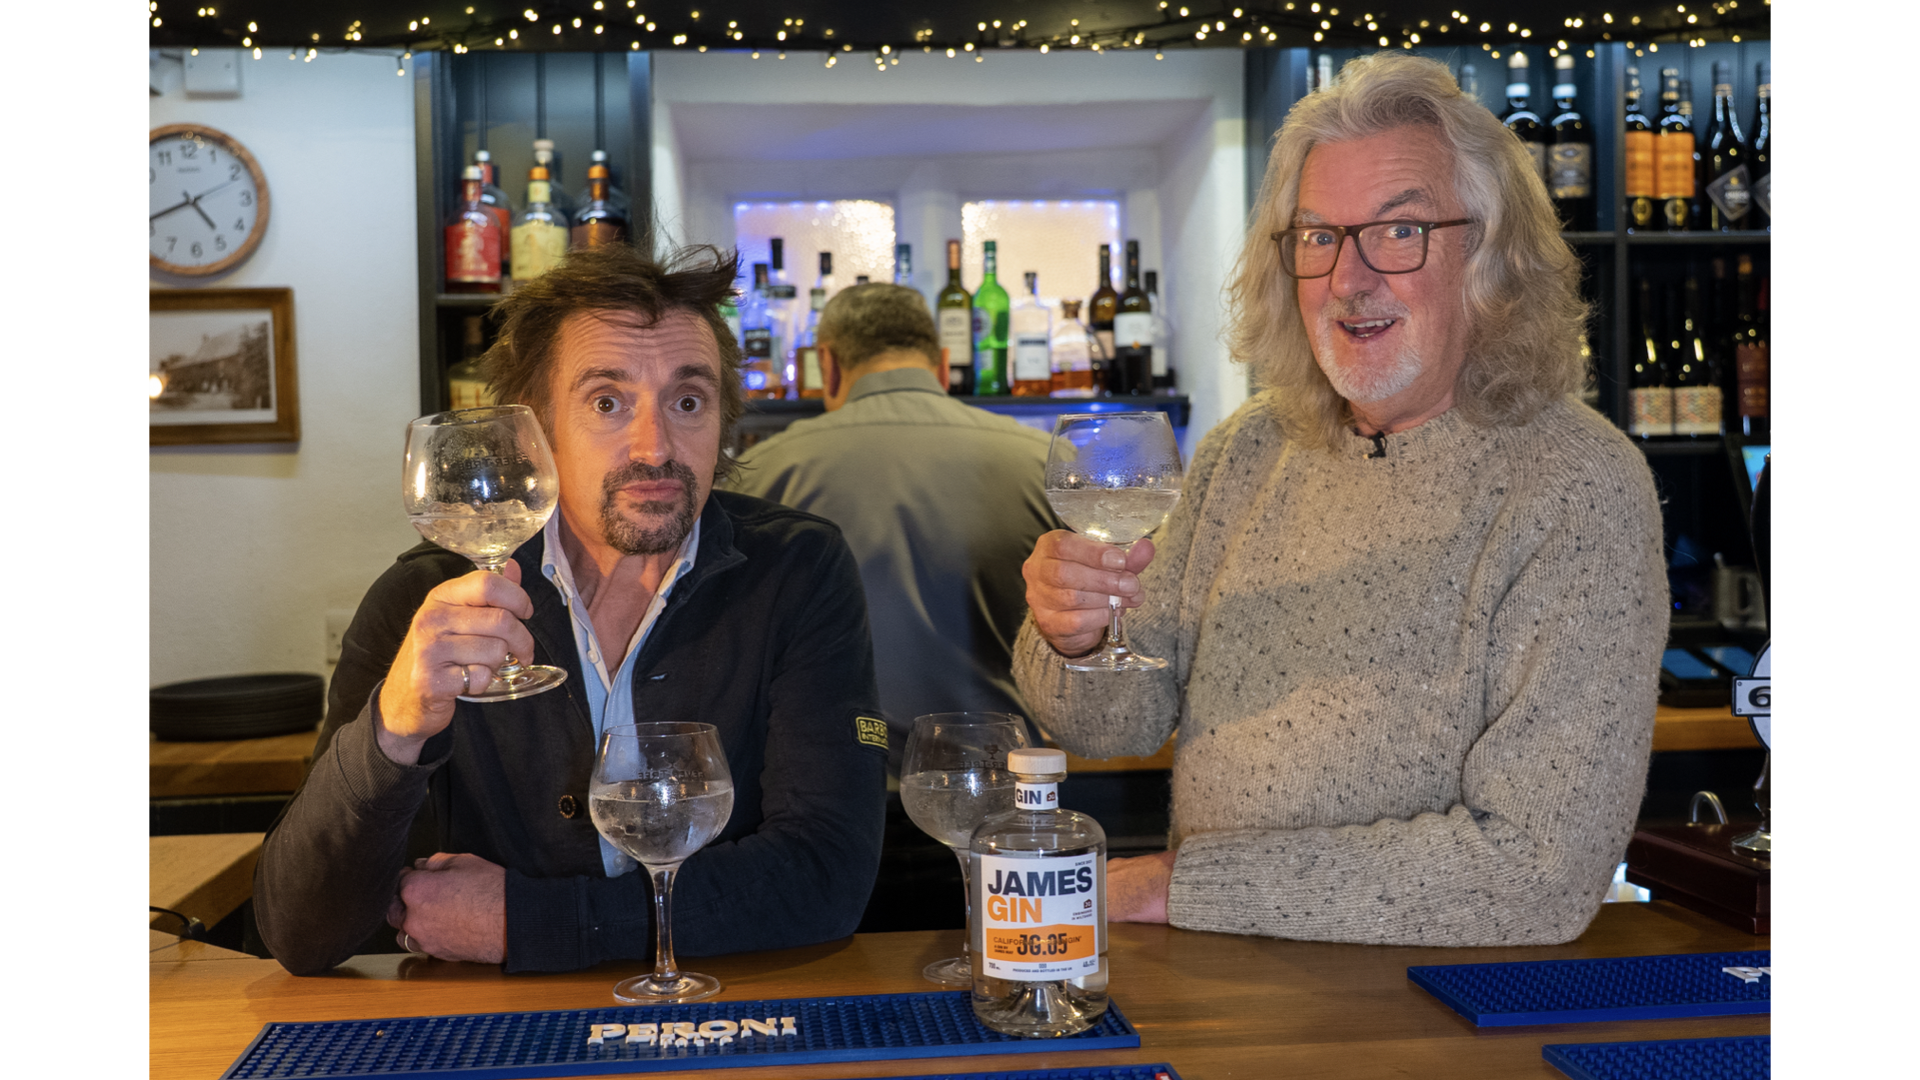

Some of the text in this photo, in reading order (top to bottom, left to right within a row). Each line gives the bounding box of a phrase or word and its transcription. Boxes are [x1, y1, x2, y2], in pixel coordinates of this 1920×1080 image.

[158, 150, 173, 167] 11
[180, 141, 199, 160] 12
[209, 149, 217, 164] 1
[229, 163, 242, 181] 2
[239, 189, 253, 207] 3
[234, 217, 245, 233] 4
[166, 235, 178, 252] 7
[190, 241, 203, 259] 6
[214, 234, 227, 252] 5
[1016, 788, 1042, 805] GIN
[987, 866, 1093, 897] JAMES
[987, 895, 1043, 923] GIN
[1017, 933, 1068, 956] JG.05
[587, 1016, 797, 1045] PERONI
